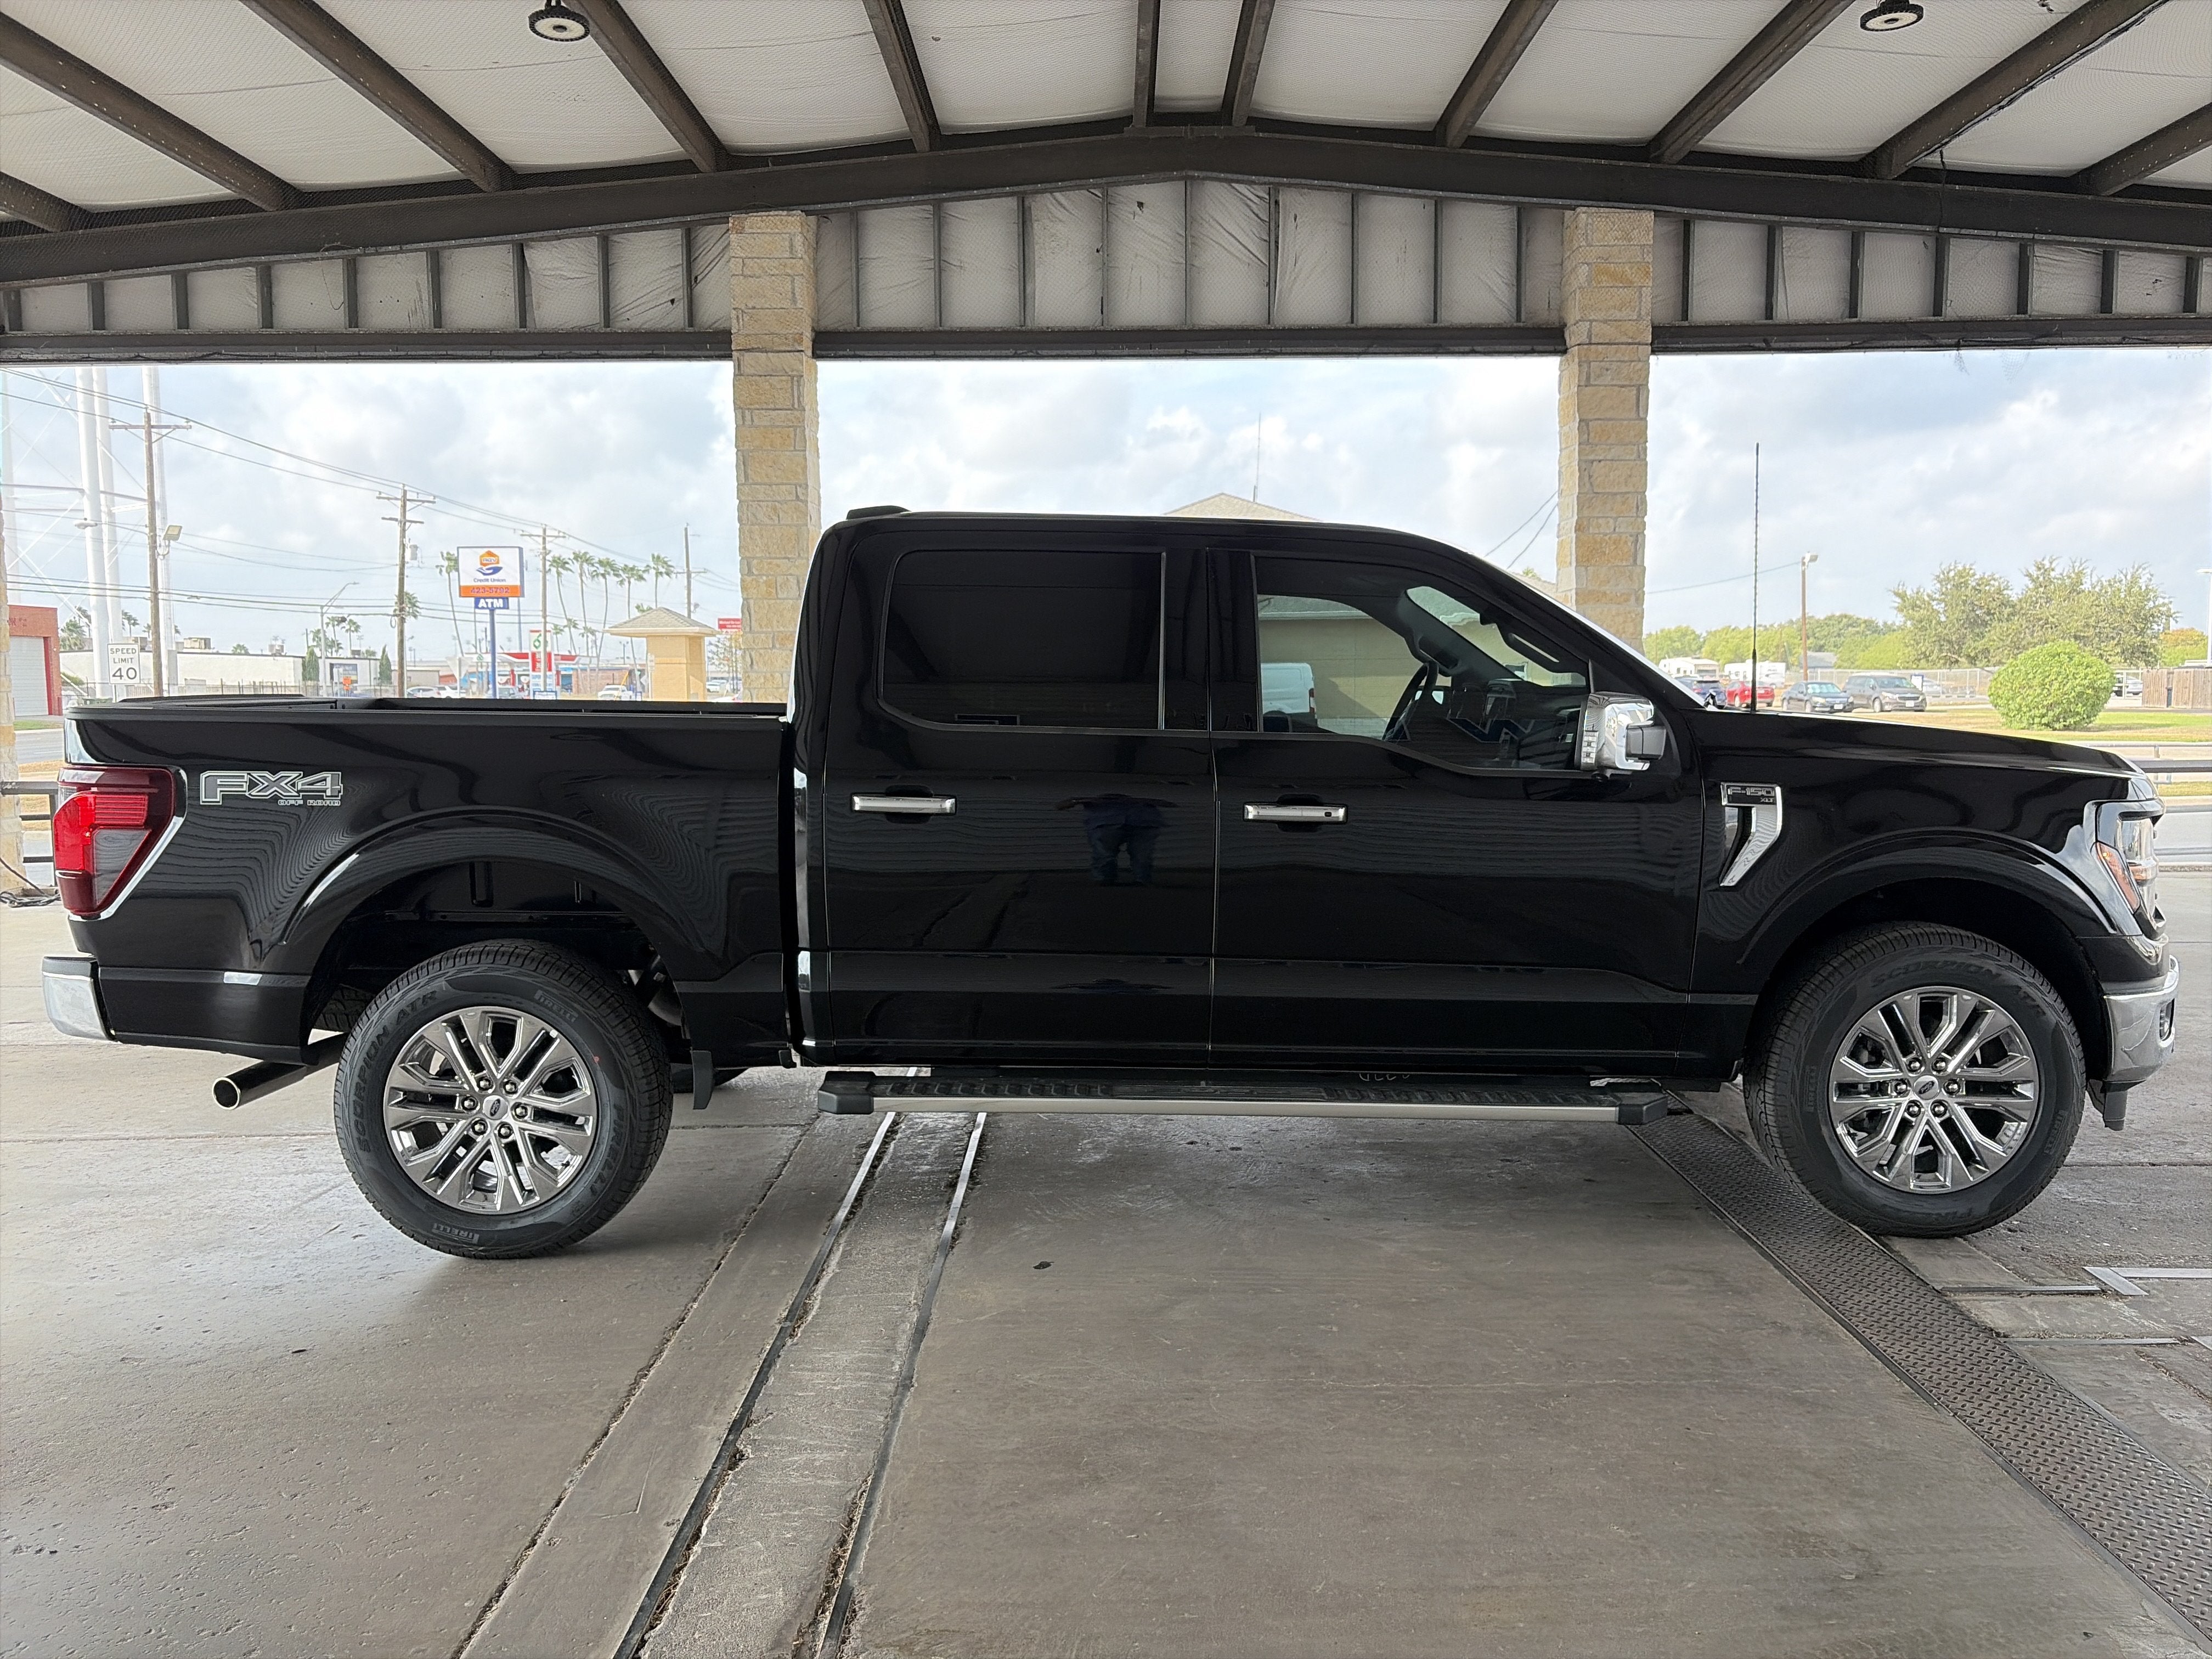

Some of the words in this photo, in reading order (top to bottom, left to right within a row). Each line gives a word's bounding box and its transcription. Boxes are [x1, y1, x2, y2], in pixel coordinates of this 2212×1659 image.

[478, 598, 504, 608] ATM
[112, 667, 137, 680] 40
[200, 770, 343, 805] FX4
[1728, 787, 1774, 796] F-150
[533, 989, 579, 1023] PIRELLI
[354, 1024, 390, 1153] SCORPION
[396, 990, 437, 1026] ATR
[591, 1103, 624, 1196] PIRELLI
[431, 1222, 480, 1245] PIRELLI
